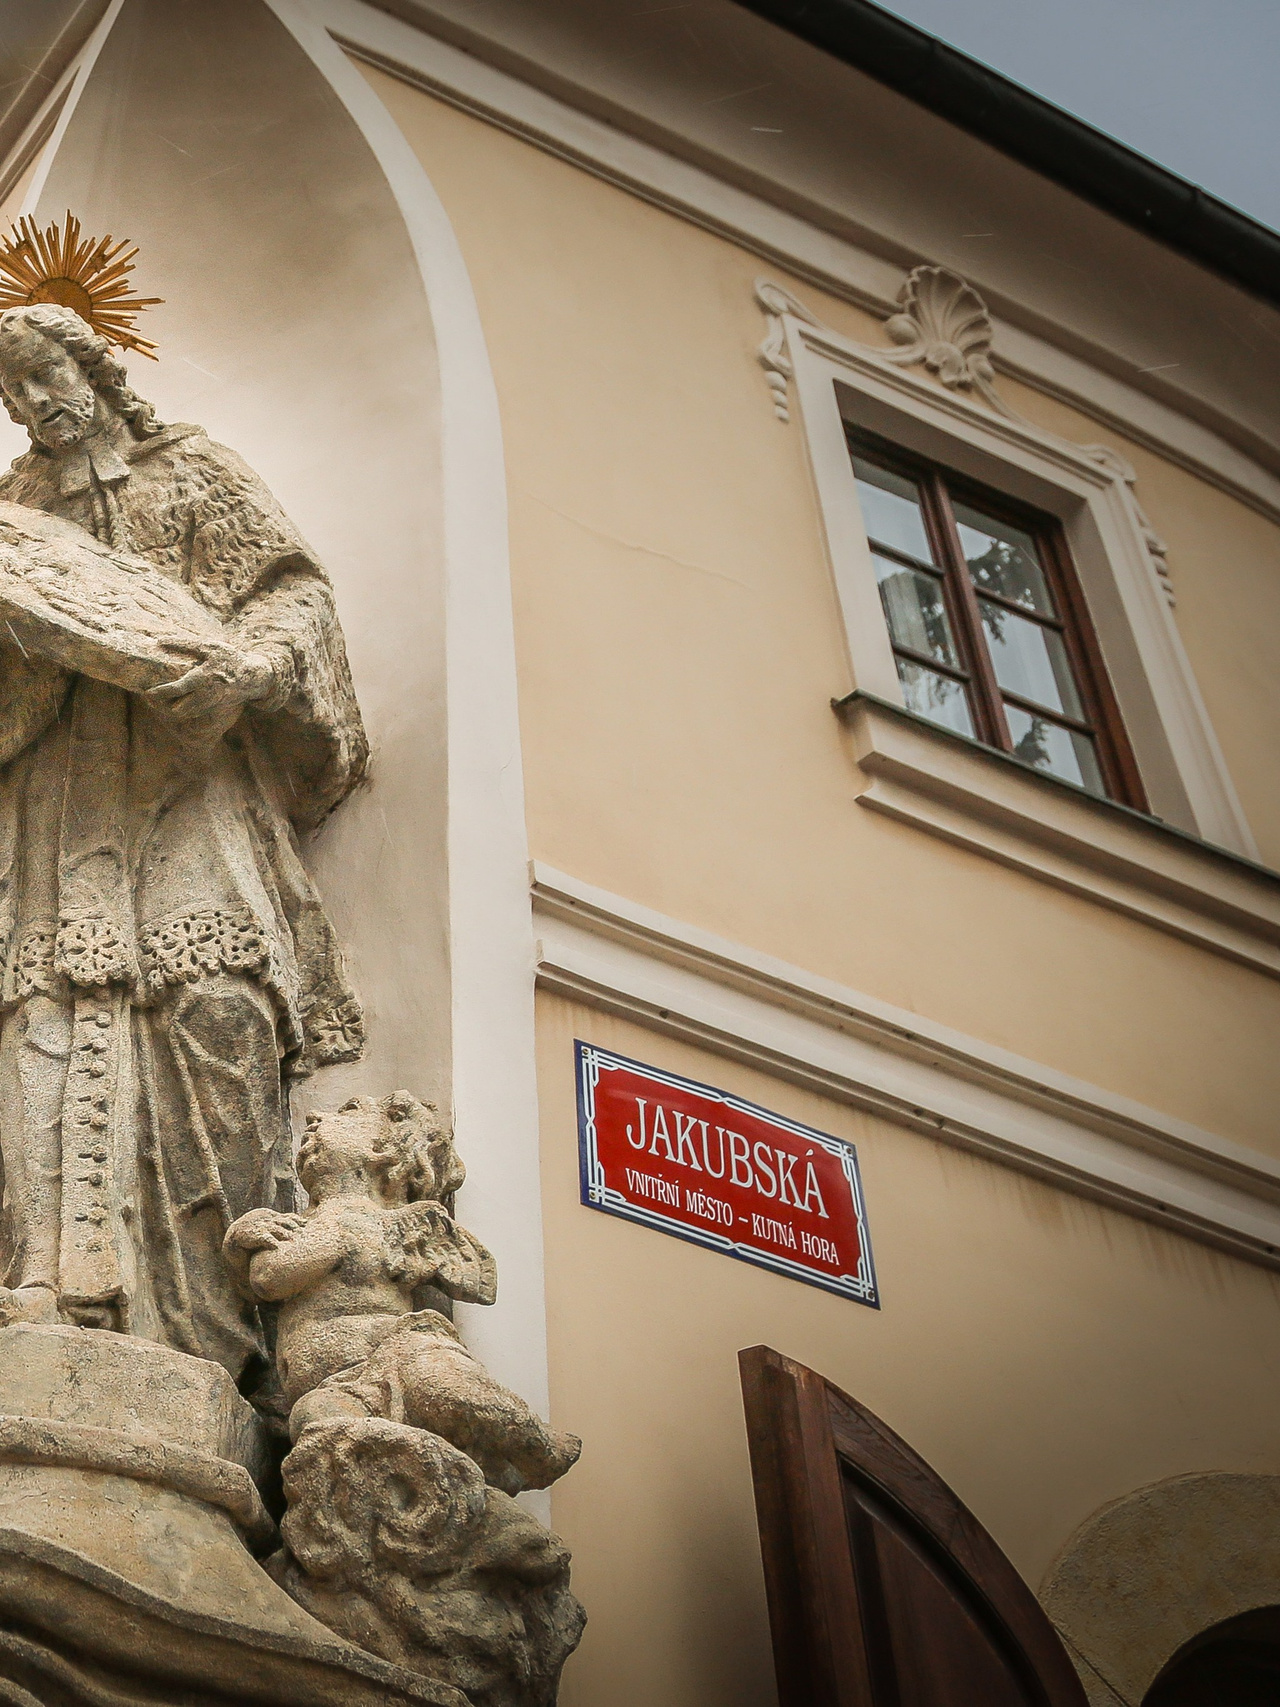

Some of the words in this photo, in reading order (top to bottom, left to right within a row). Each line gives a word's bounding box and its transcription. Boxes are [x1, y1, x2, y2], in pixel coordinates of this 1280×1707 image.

[625, 1097, 830, 1218] JAKUBSKÁ
[625, 1167, 680, 1208] VNITŘNÍ
[686, 1188, 733, 1227] MĚSTO
[751, 1213, 797, 1250] KUTNÁ
[800, 1231, 840, 1266] HORA
